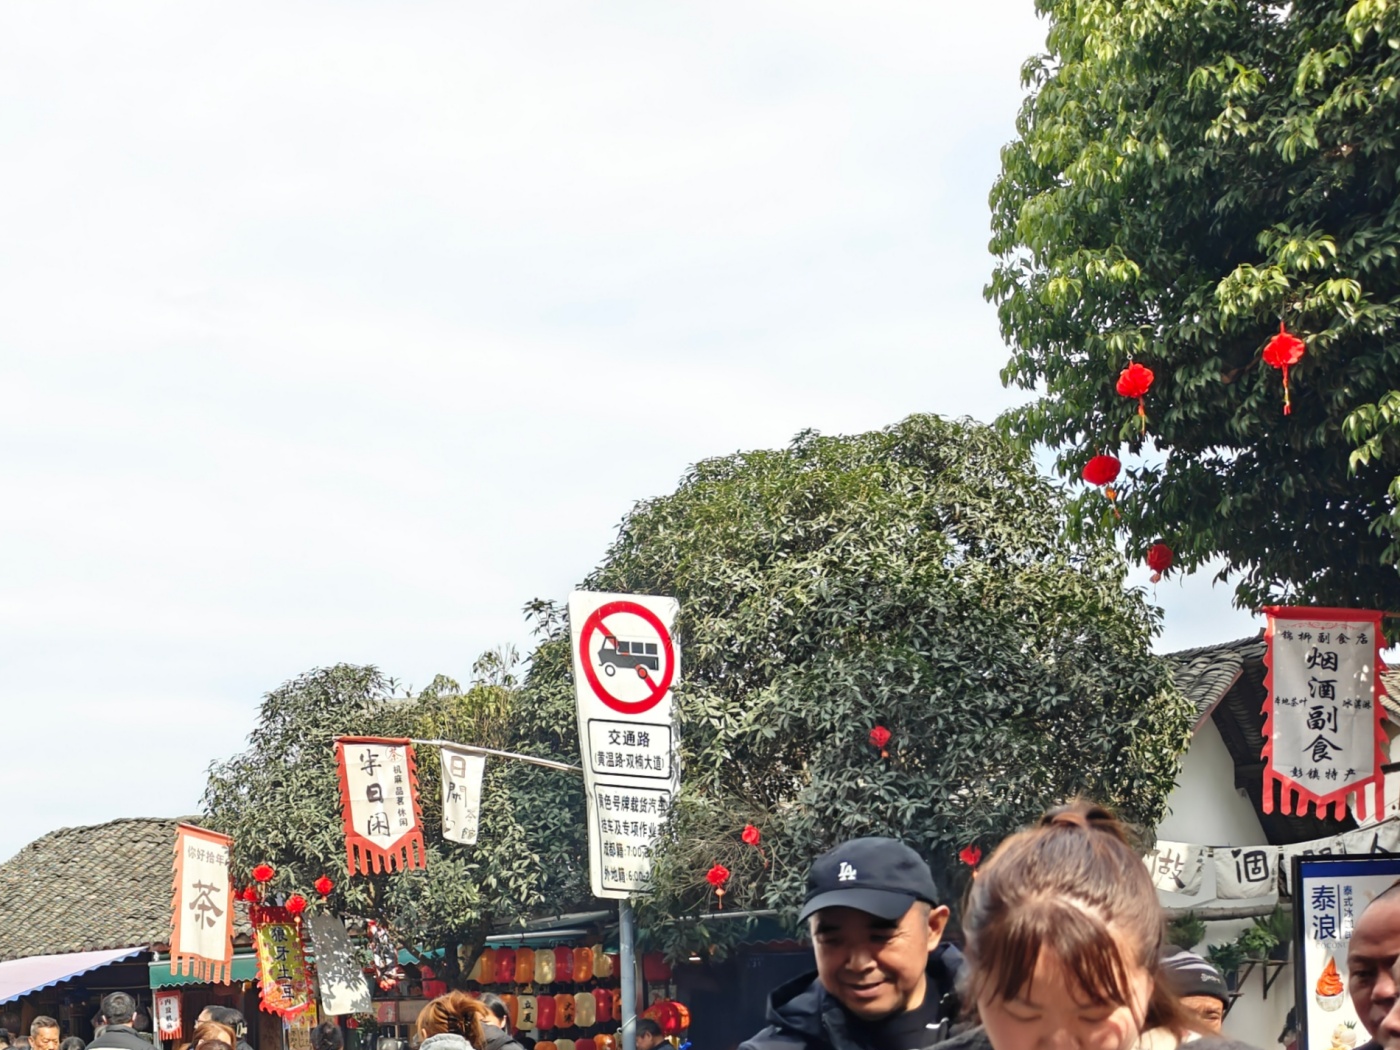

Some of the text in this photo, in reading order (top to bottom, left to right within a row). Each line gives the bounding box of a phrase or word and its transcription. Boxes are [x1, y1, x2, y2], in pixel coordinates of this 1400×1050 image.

[1303, 647, 1343, 762] 烟酒副食
[608, 729, 650, 748] 交通路
[359, 748, 391, 837] 半日闲
[1290, 766, 1356, 782] 彭镇特产
[838, 861, 857, 881] LA
[189, 878, 224, 930] 茶
[1311, 884, 1337, 940] 泰浪
[271, 926, 295, 999] 狼牙土豆
